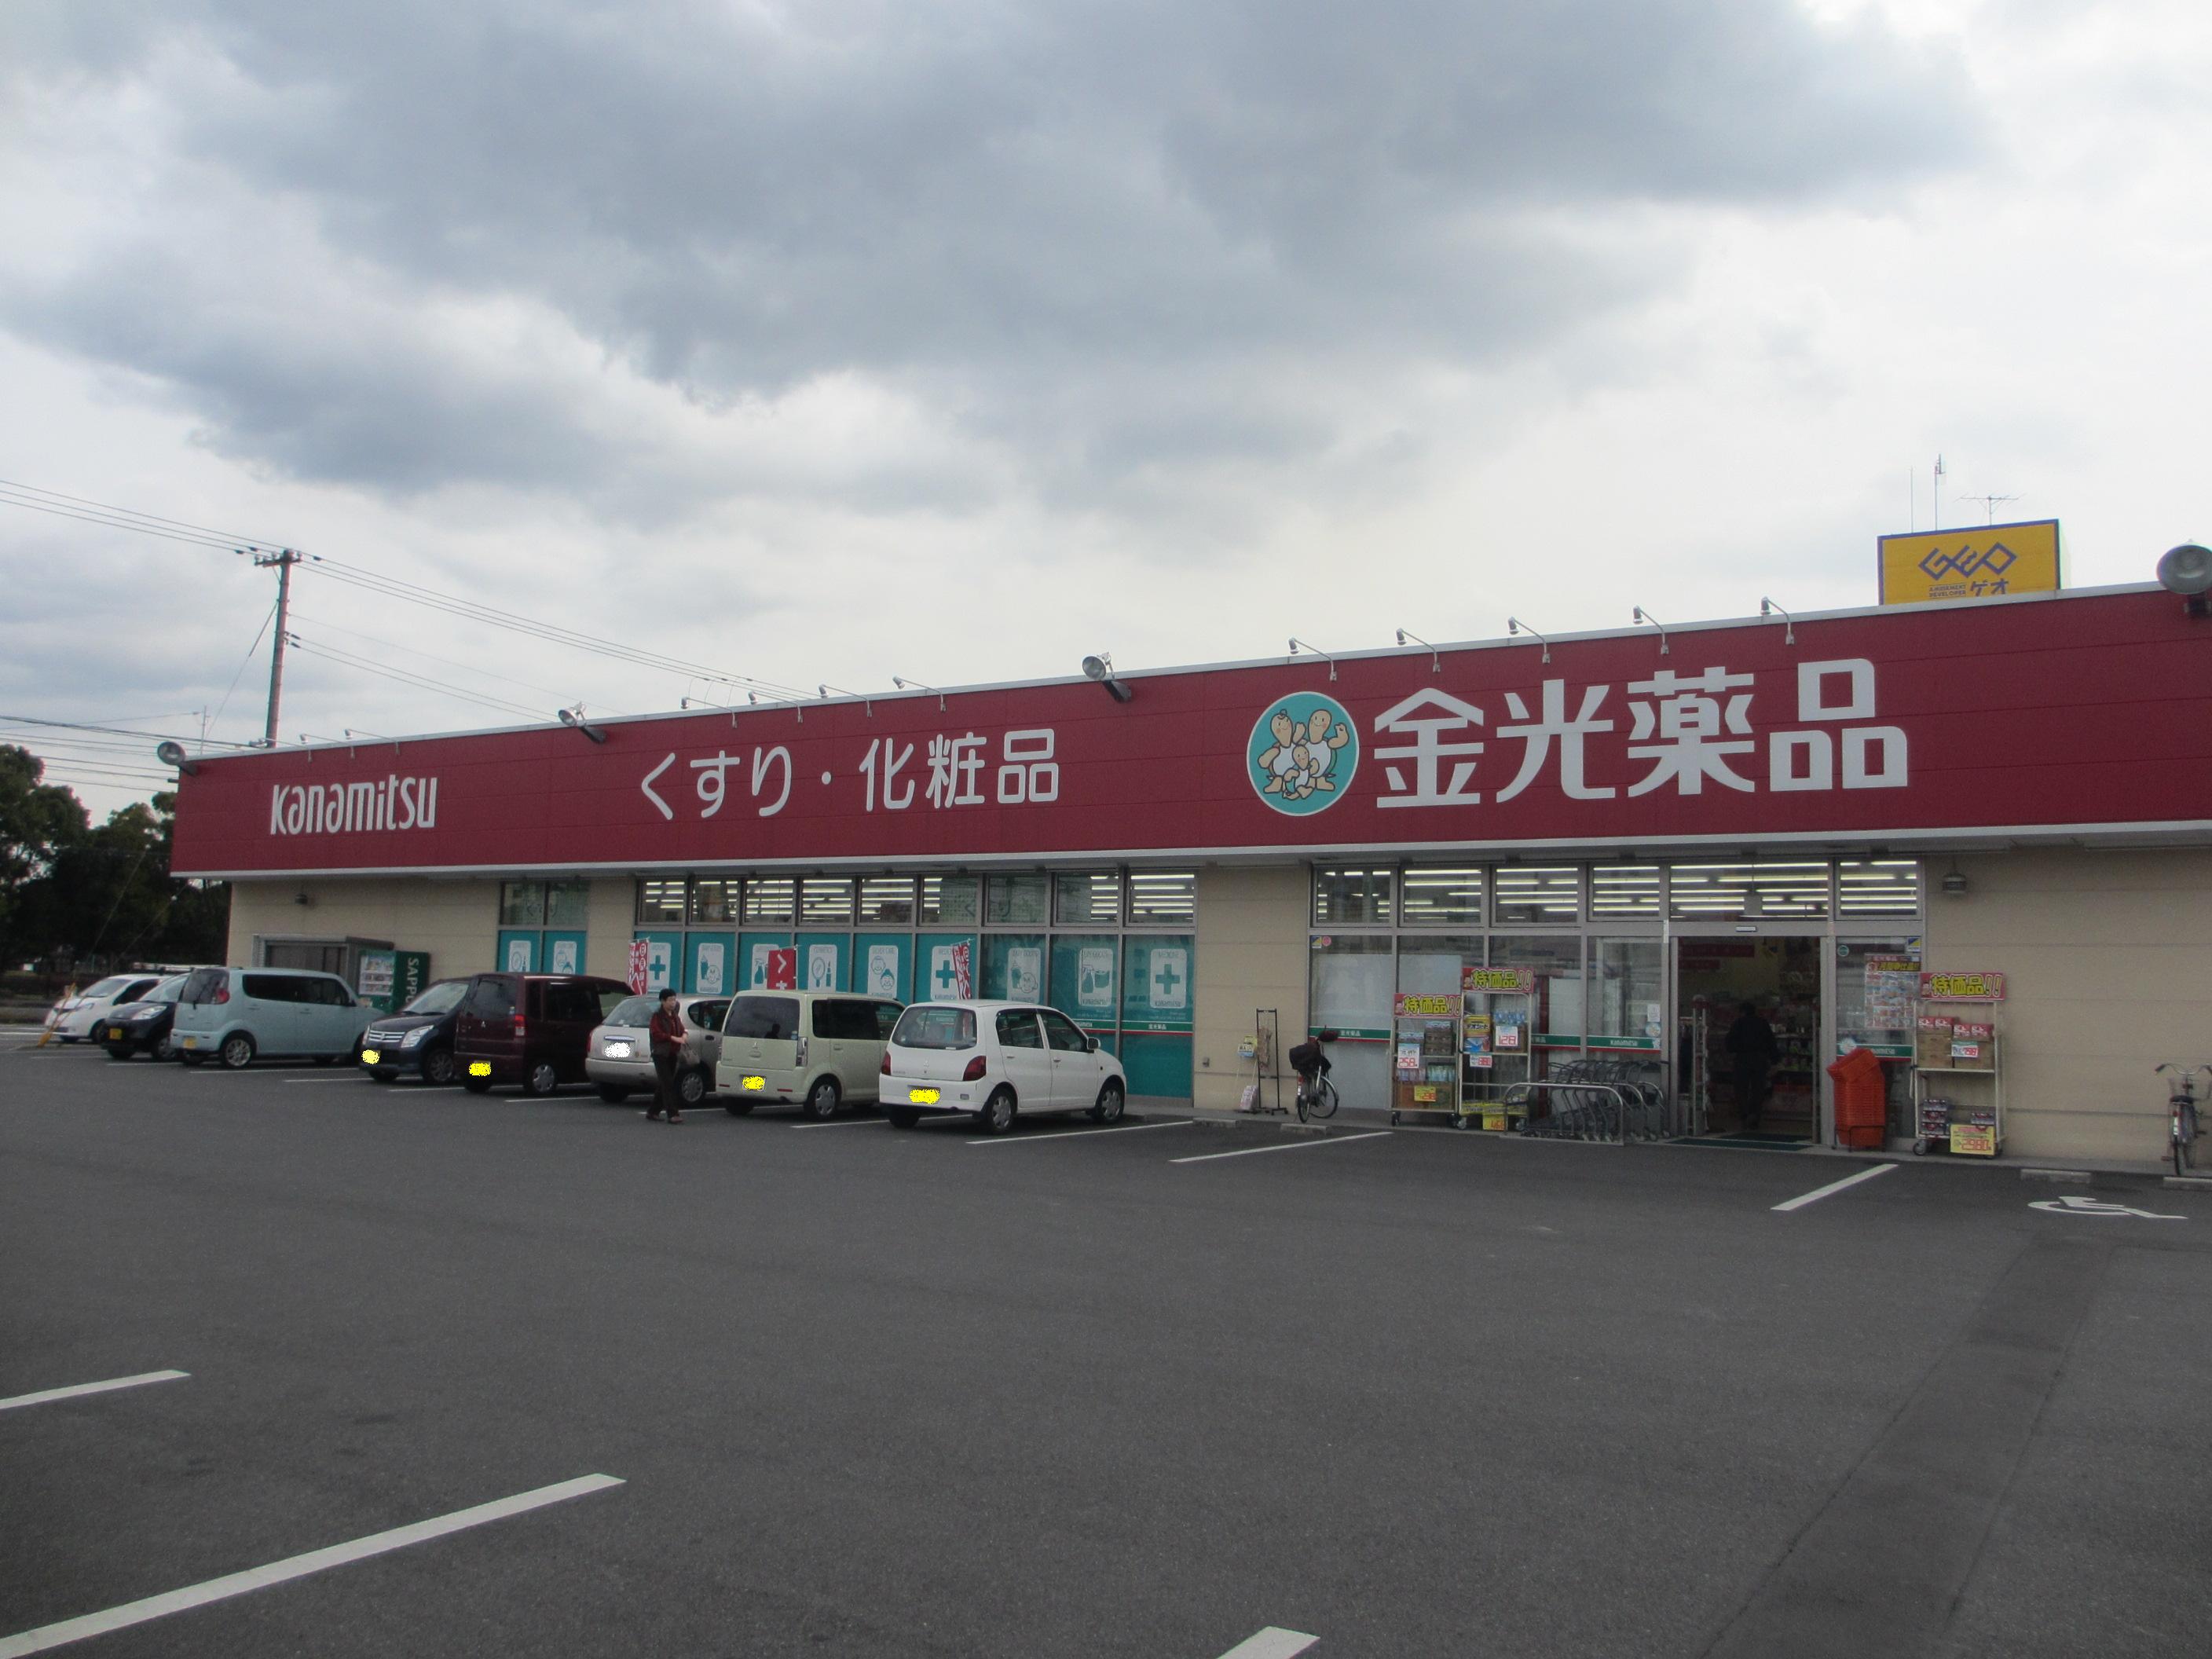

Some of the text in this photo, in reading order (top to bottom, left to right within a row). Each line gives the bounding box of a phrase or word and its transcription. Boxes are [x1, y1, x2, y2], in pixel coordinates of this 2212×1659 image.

[1917, 541, 2017, 580] GEO
[1970, 578, 2009, 597] ゲオ
[1374, 657, 1908, 809] 金光薬品
[640, 728, 1060, 820] くすり・化粧品
